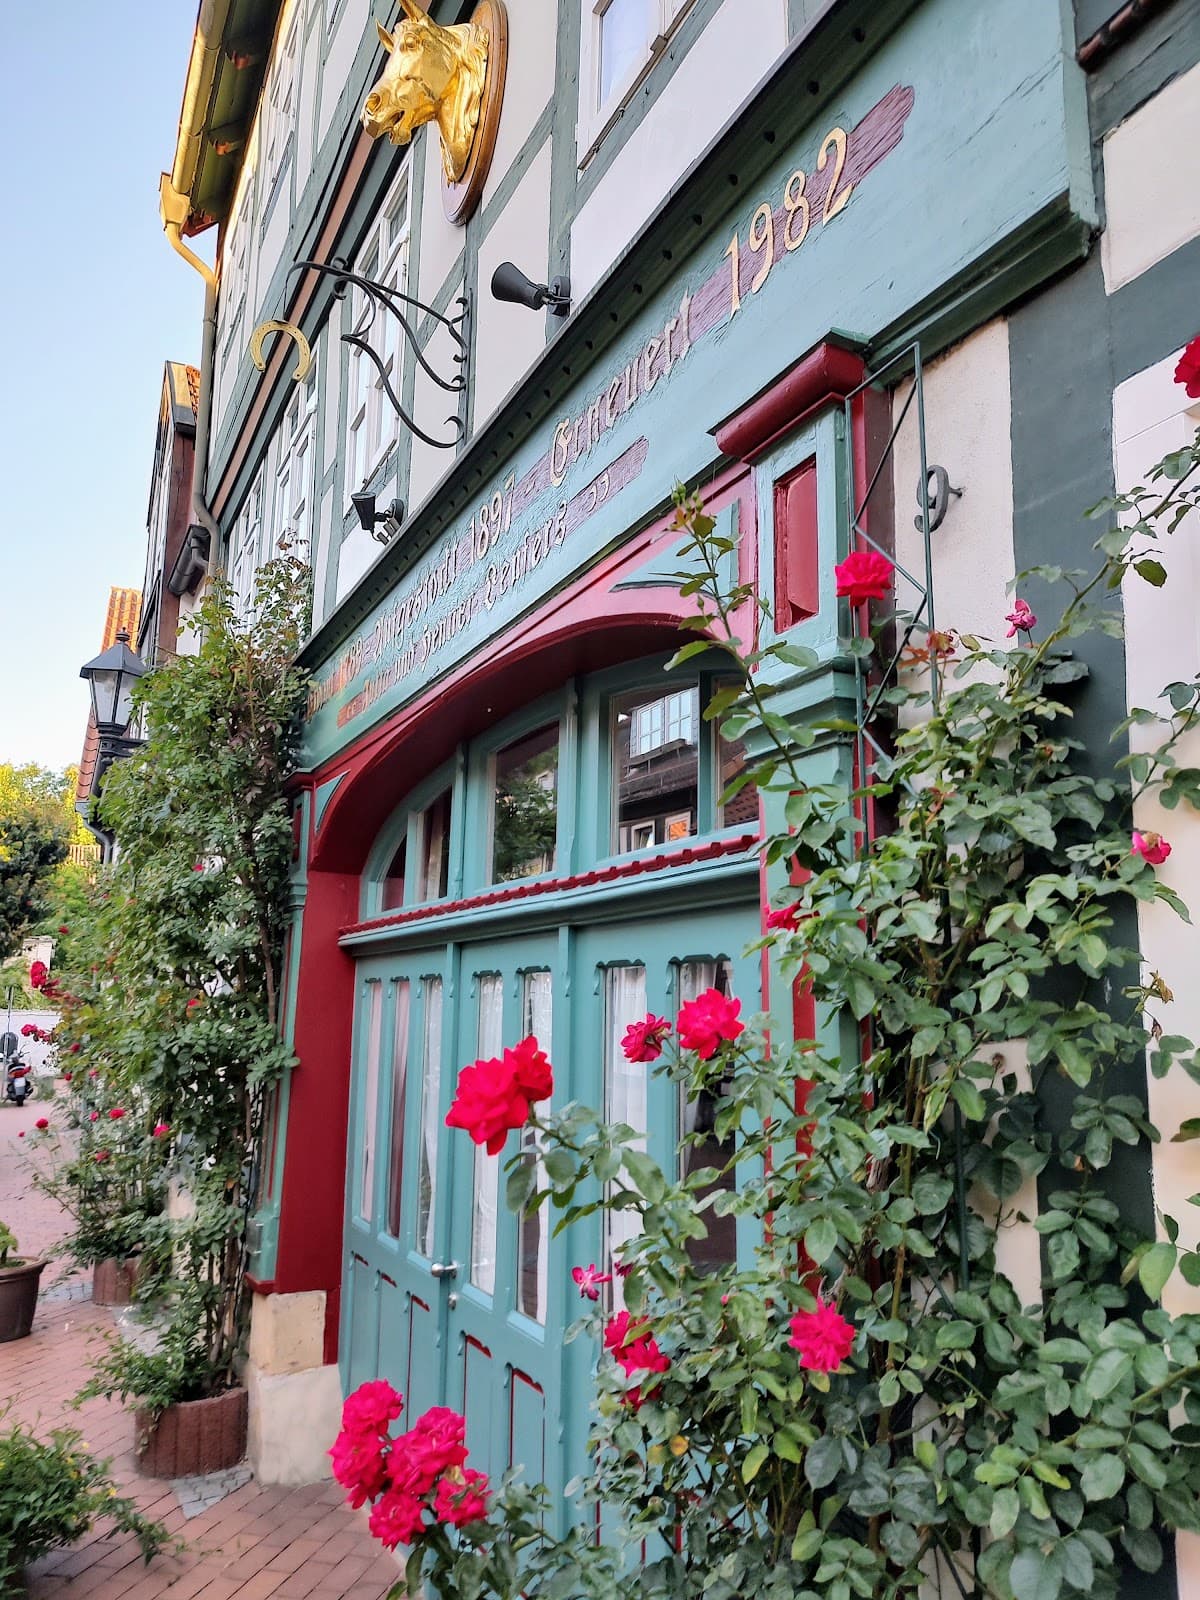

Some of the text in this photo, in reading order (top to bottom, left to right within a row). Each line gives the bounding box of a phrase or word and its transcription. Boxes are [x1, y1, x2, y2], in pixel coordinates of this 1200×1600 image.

[470, 470, 515, 568] 1897
[550, 287, 692, 487] Erneuert
[725, 126, 854, 318] 1982
[914, 464, 950, 533] 9
